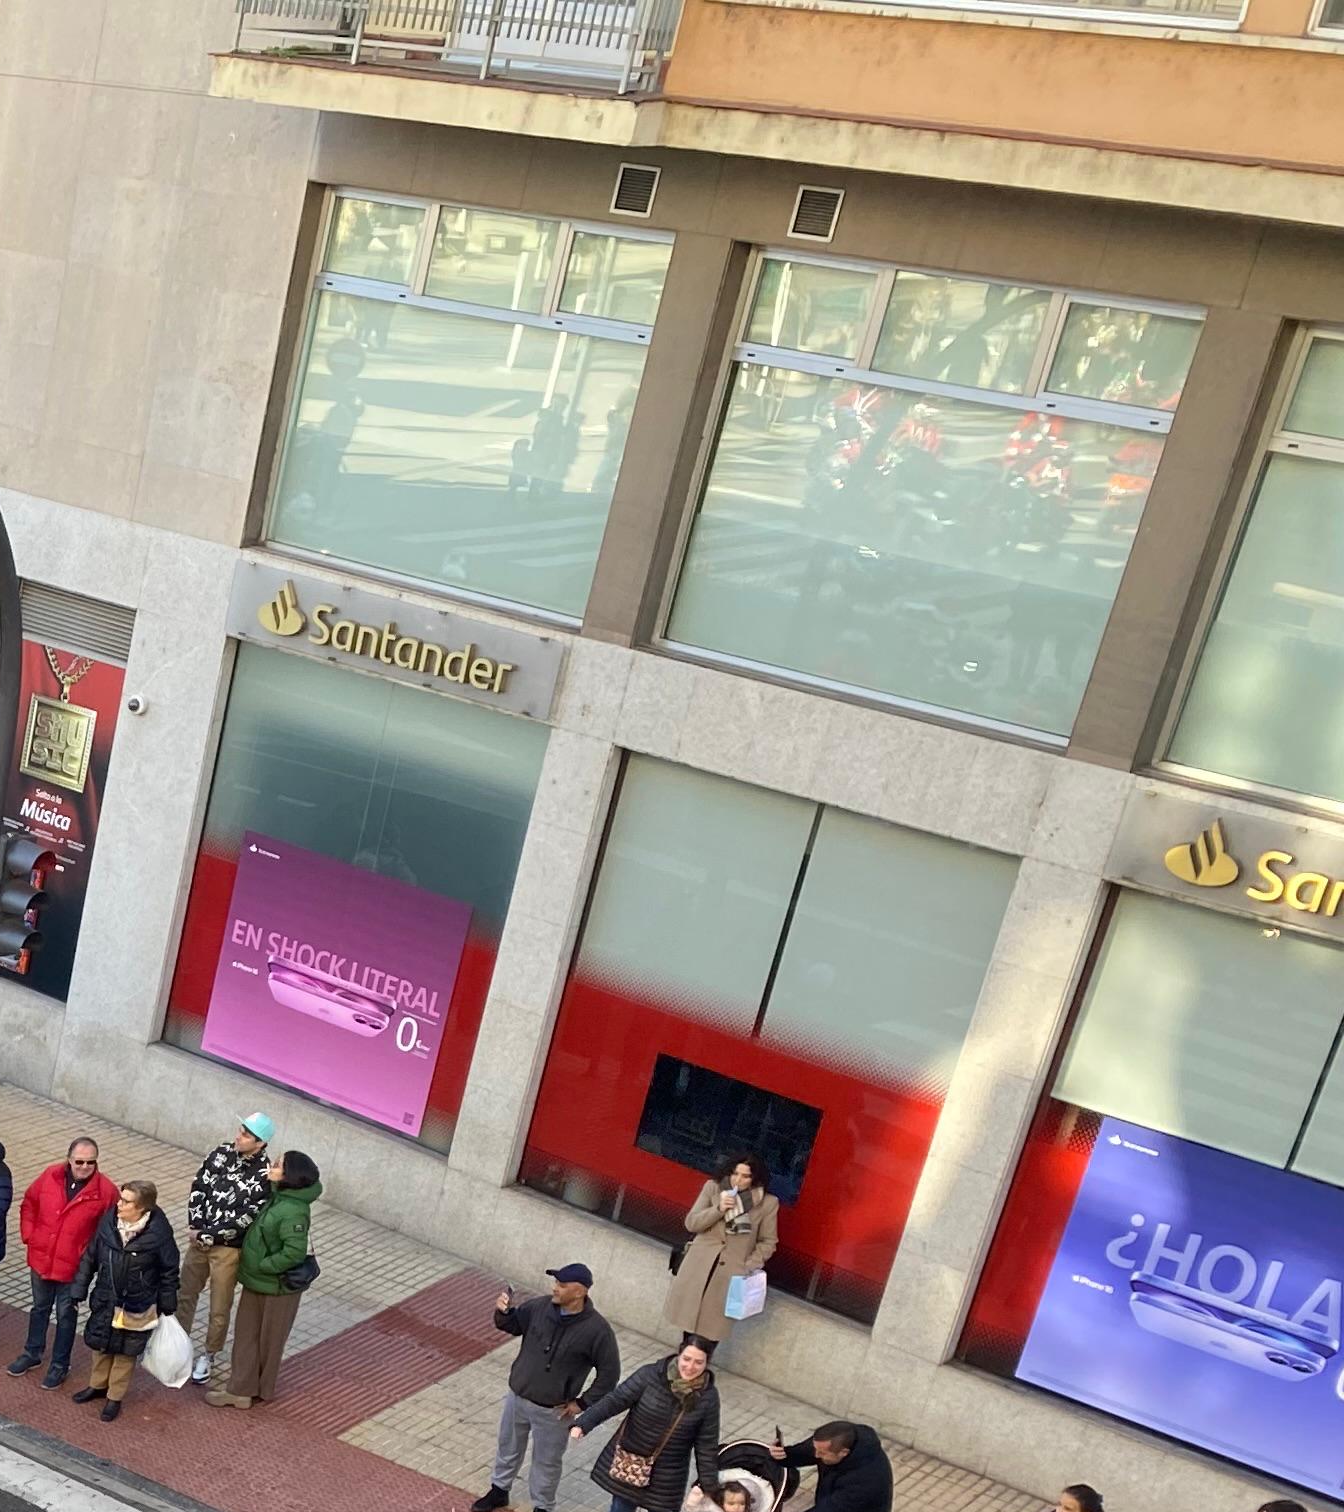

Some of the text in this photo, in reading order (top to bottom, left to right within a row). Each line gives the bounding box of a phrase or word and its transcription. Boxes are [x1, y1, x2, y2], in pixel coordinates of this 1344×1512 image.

[308, 603, 514, 694] Santander
[19, 798, 72, 831] Música
[232, 919, 441, 1019] EN SHOCK LITERAL
[396, 1016, 418, 1052] 0
[1105, 1213, 1343, 1337] ¿HOLA
